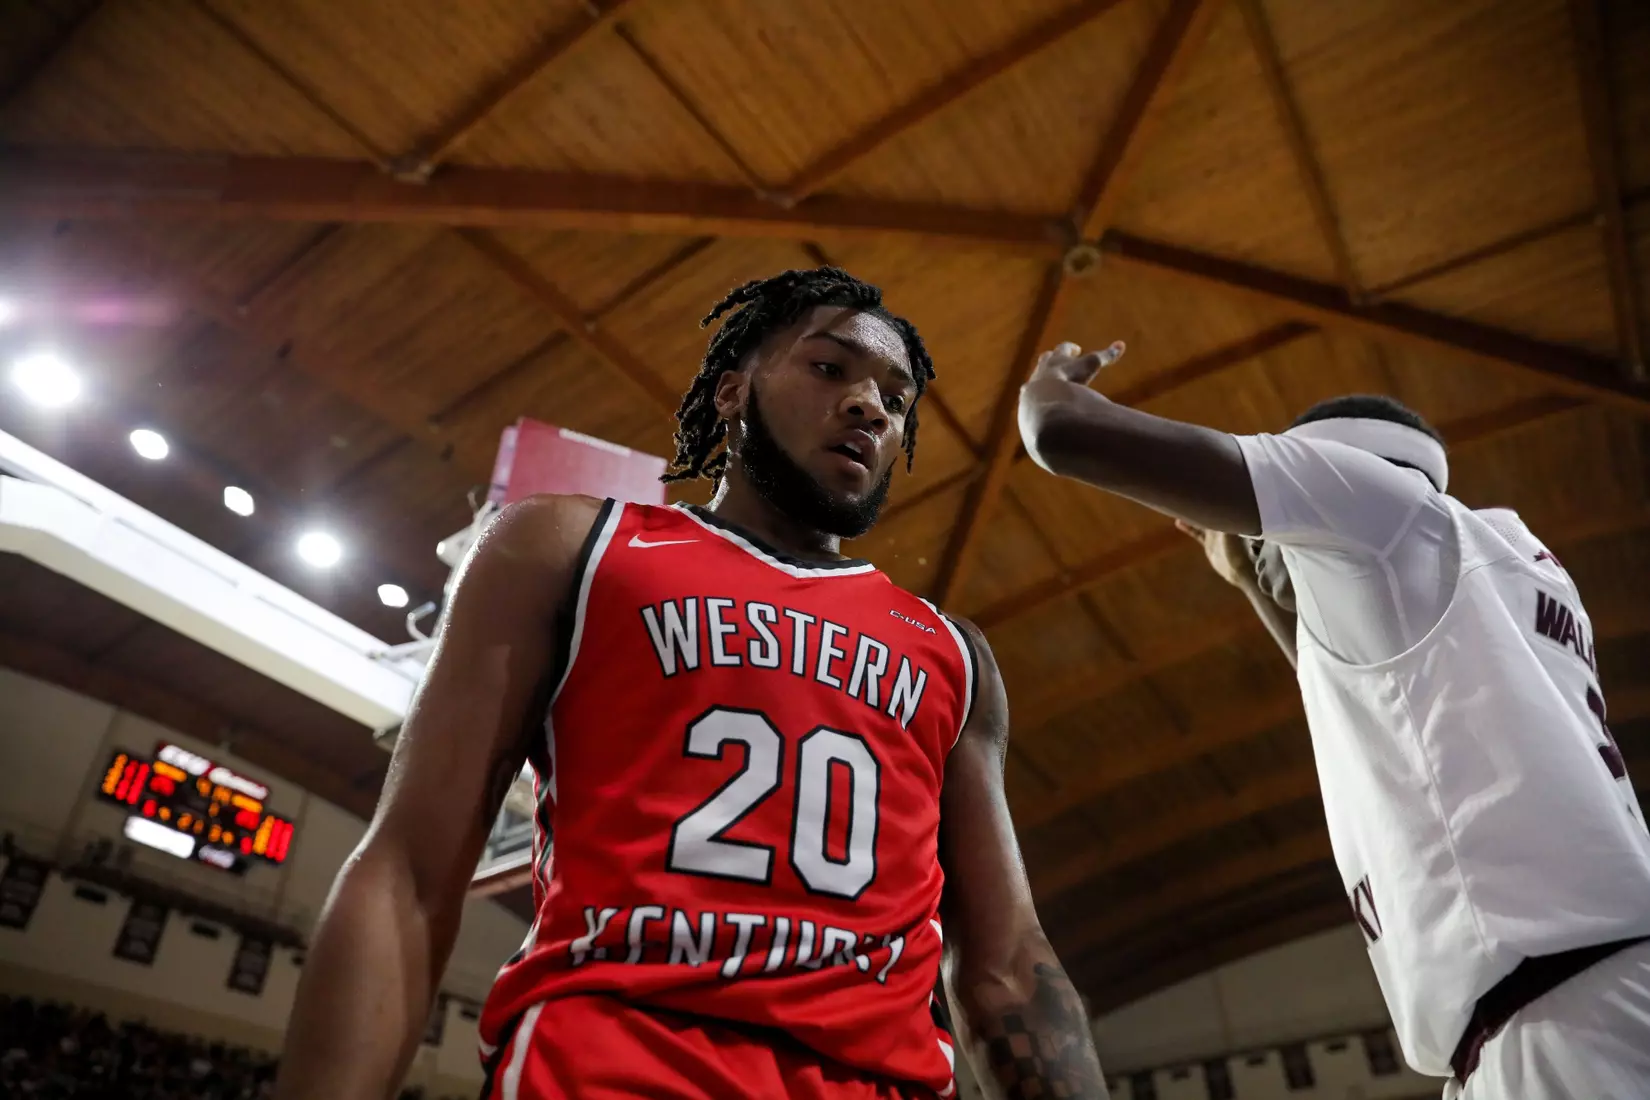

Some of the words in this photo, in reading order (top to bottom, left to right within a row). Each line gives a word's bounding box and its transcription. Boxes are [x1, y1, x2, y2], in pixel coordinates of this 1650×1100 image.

[640, 597, 928, 731] WESTERN
[667, 705, 879, 898] 20
[570, 905, 906, 984] KENTUCY
